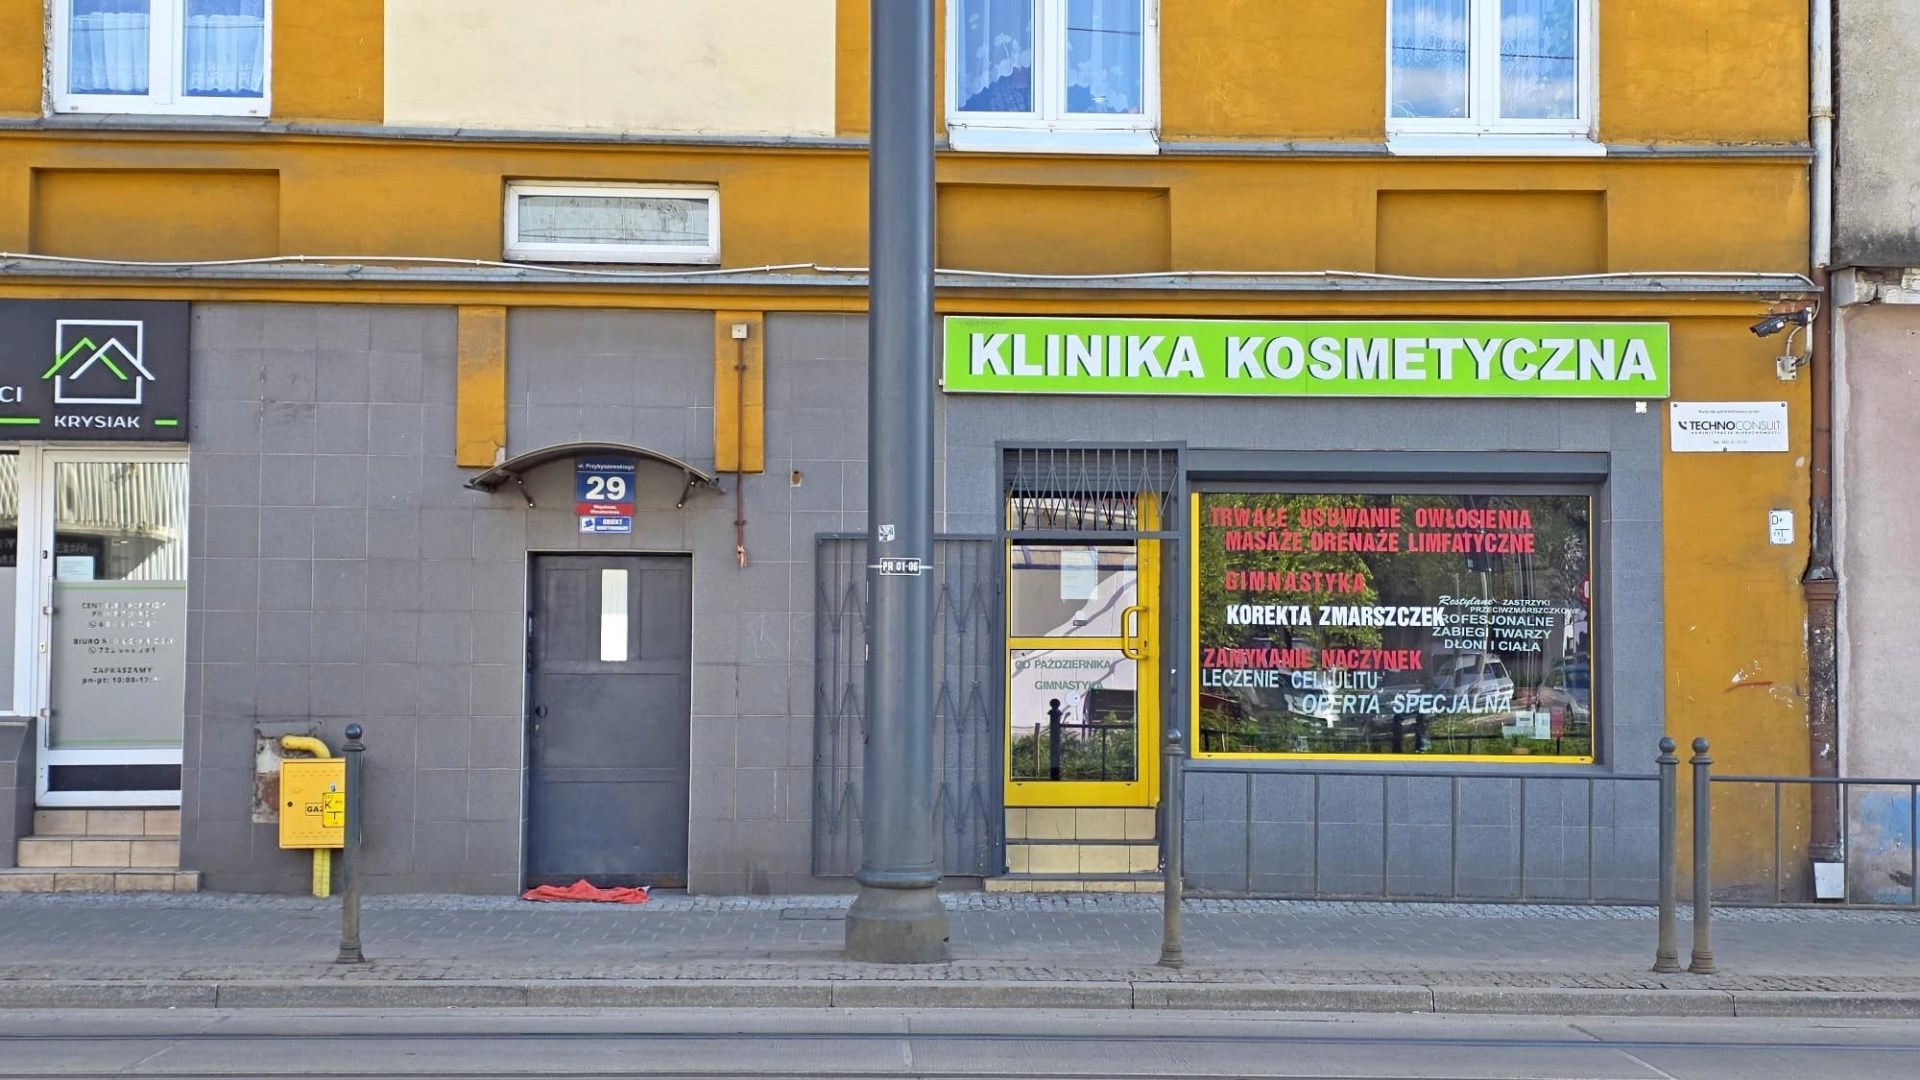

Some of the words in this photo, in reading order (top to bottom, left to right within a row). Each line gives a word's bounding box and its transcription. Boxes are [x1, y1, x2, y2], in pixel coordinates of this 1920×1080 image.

[969, 333, 1205, 378] KLINIKA
[1225, 336, 1657, 381] KOSMETYCZNA
[54, 415, 140, 428] KRYSIAK
[1690, 421, 1780, 430] TECHNOCONSULT
[585, 476, 626, 500] 29
[1301, 508, 1401, 528] USUWANIE
[1415, 508, 1532, 529] OWŁOSIENIA
[1225, 529, 1303, 552] MASAŻE
[1311, 529, 1400, 553] DRENAŻE
[1408, 533, 1535, 553] LIMFATYCZNE
[882, 561, 894, 571] PR
[1225, 570, 1368, 593] GIMNASTYKA
[1438, 595, 1495, 607] Restylane
[1227, 605, 1312, 625] KOREKTA
[1319, 606, 1446, 627] ZMARSZCZEK
[1440, 614, 1554, 627] ROFESJONALNE
[1432, 627, 1489, 638] ZABIEGI
[1493, 628, 1552, 639] TWARZY
[1444, 639, 1487, 650] DŁONI
[1491, 640, 1494, 650] I
[1498, 640, 1541, 652] CIAŁA
[1015, 659, 1030, 669] OD
[1203, 648, 1314, 669] ZAMYKANIE
[1321, 649, 1423, 670] NACZYNEK
[1035, 681, 1104, 690] GIMNASTYKA
[1203, 669, 1279, 688] LECZENIE
[1291, 670, 1378, 690] CELLULITU
[1302, 694, 1380, 714] OFERTA
[1392, 695, 1512, 714] SPECJALNA
